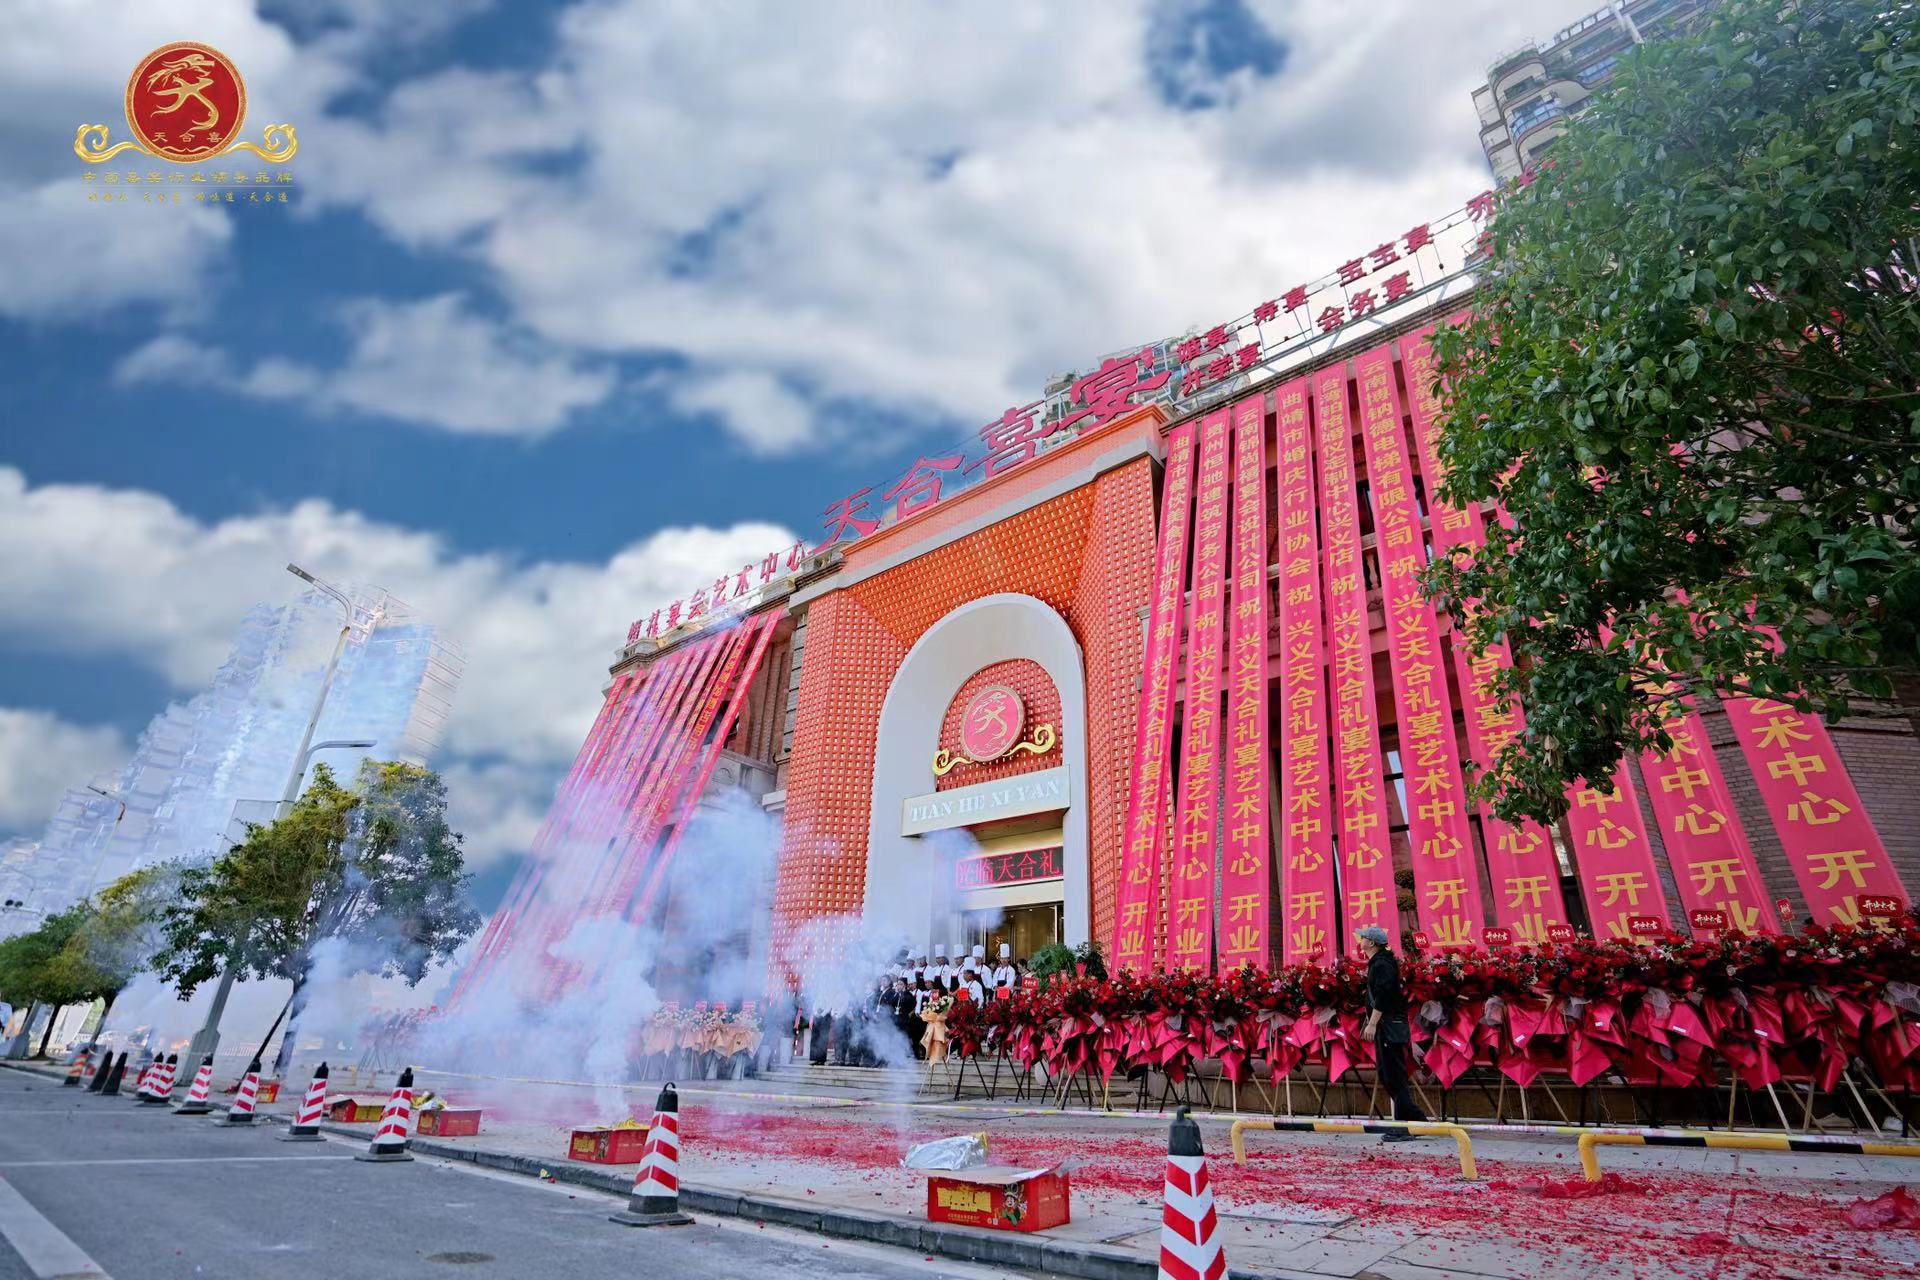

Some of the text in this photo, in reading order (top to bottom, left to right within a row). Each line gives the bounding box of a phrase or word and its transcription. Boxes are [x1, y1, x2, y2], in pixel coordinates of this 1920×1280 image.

[910, 779, 1061, 823] TIAN HE XI YAN
